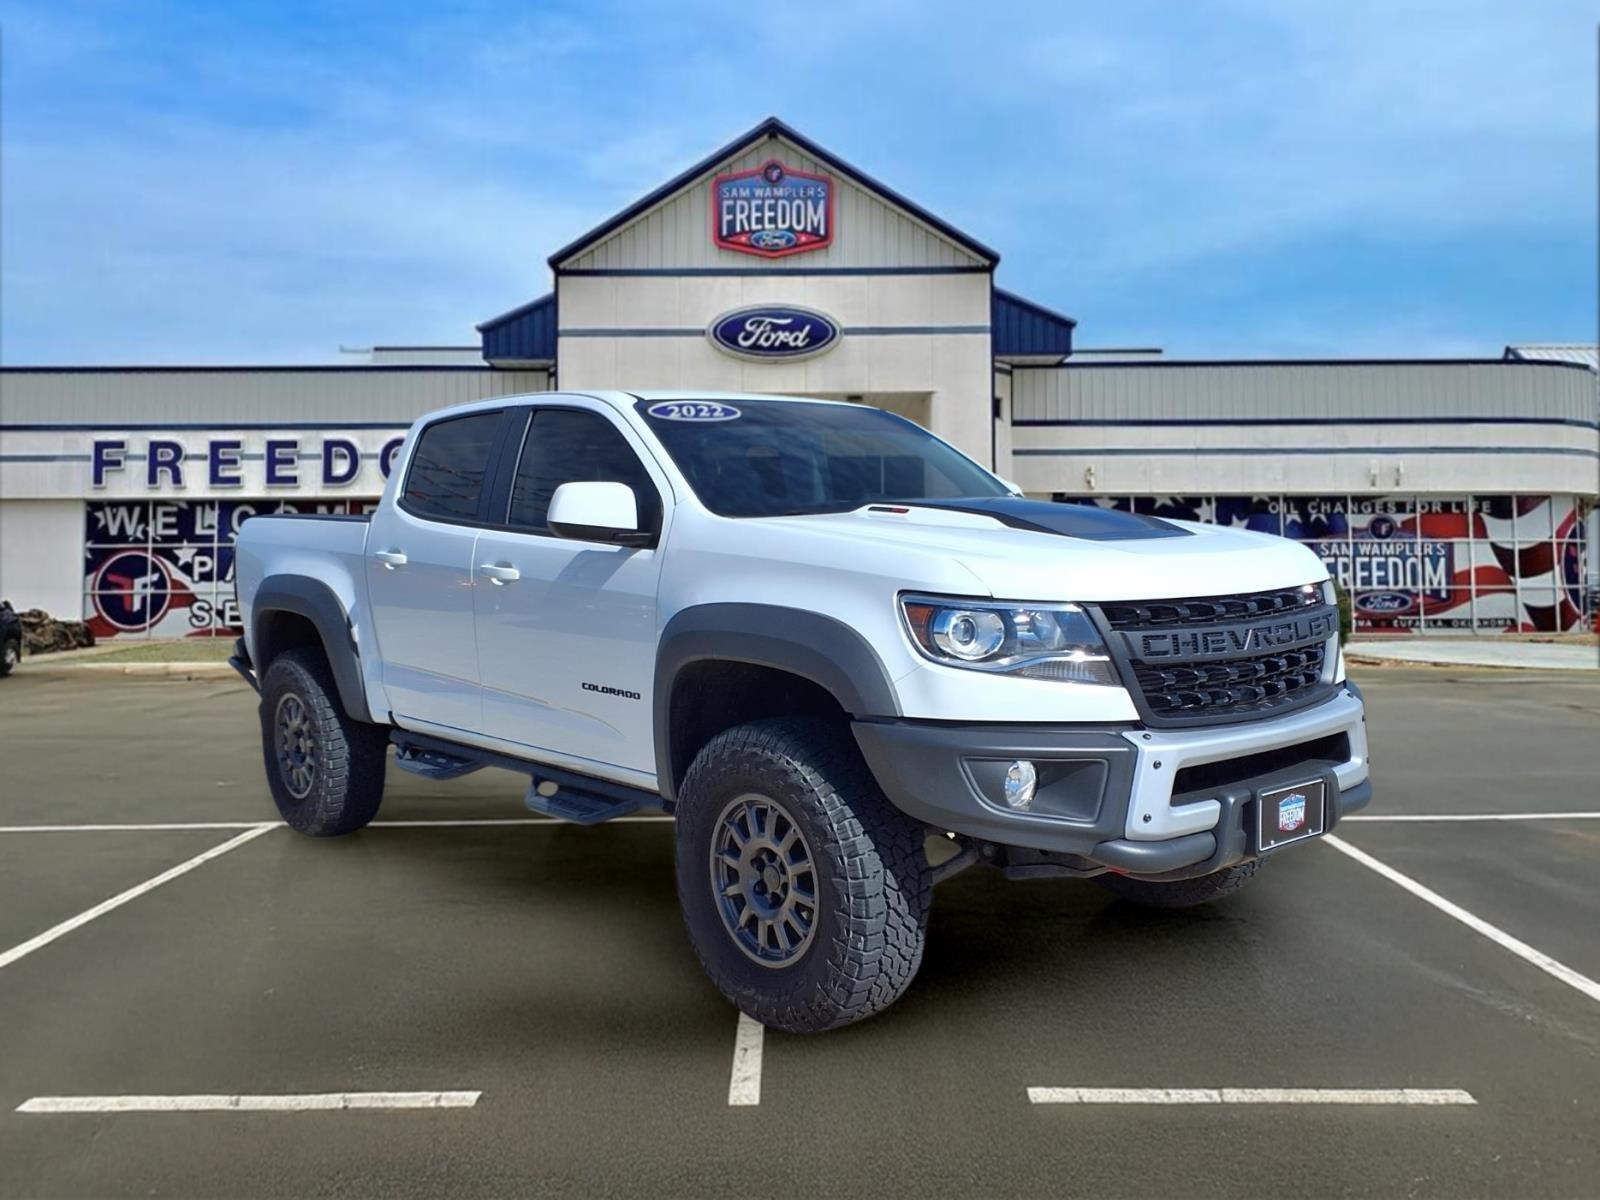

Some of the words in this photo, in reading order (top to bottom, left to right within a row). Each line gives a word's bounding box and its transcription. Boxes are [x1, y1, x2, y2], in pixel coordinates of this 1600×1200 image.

[721, 187, 750, 198] SAM
[721, 200, 825, 236] FREEDOM
[738, 316, 811, 348] Ford
[667, 405, 724, 417] 2022
[1268, 501, 1299, 514] OIL
[1308, 501, 1397, 514] CHANGES
[1405, 501, 1442, 514] FOR
[1452, 501, 1492, 514] LIFE
[1321, 543, 1353, 556] SAM
[1366, 595, 1401, 609] Ford
[1142, 613, 1334, 657] CHEVROLET
[581, 682, 641, 700] COLORADO
